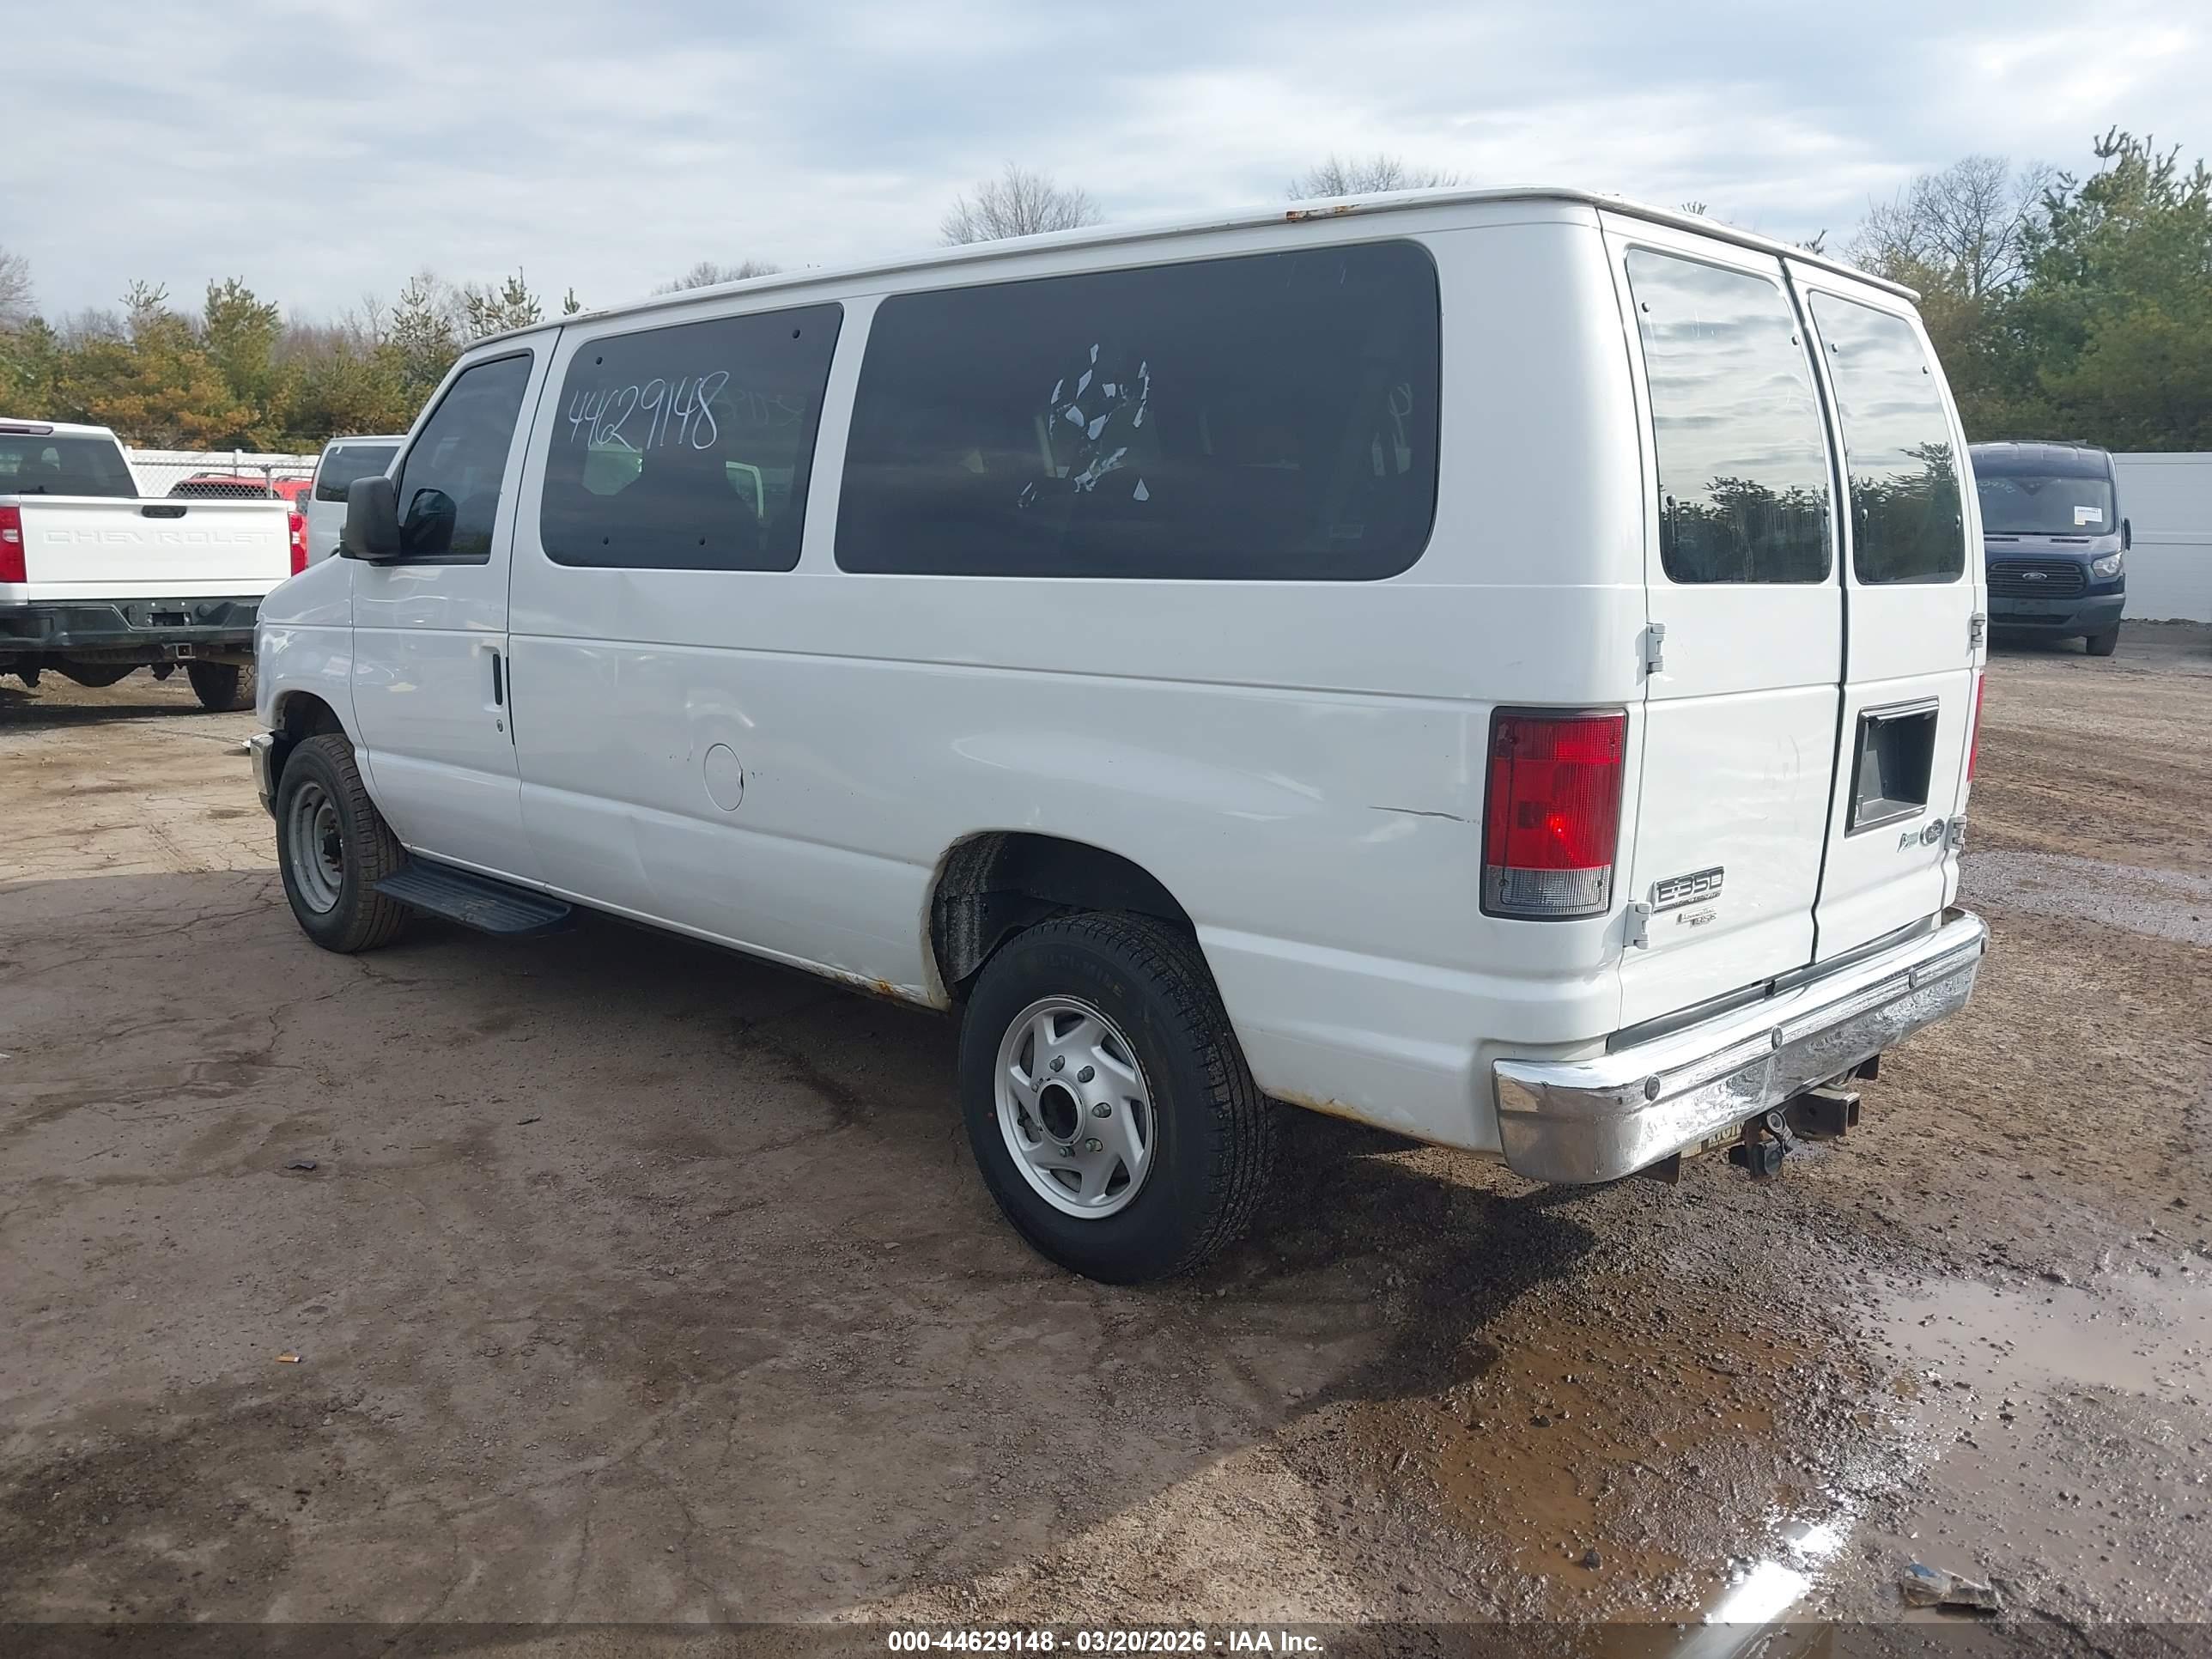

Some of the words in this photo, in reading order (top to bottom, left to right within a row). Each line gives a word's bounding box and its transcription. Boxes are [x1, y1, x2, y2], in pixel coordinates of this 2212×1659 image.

[568, 370, 730, 453] 44629148
[44, 529, 276, 544] CHEVROLET
[1656, 871, 1723, 902] E-350
